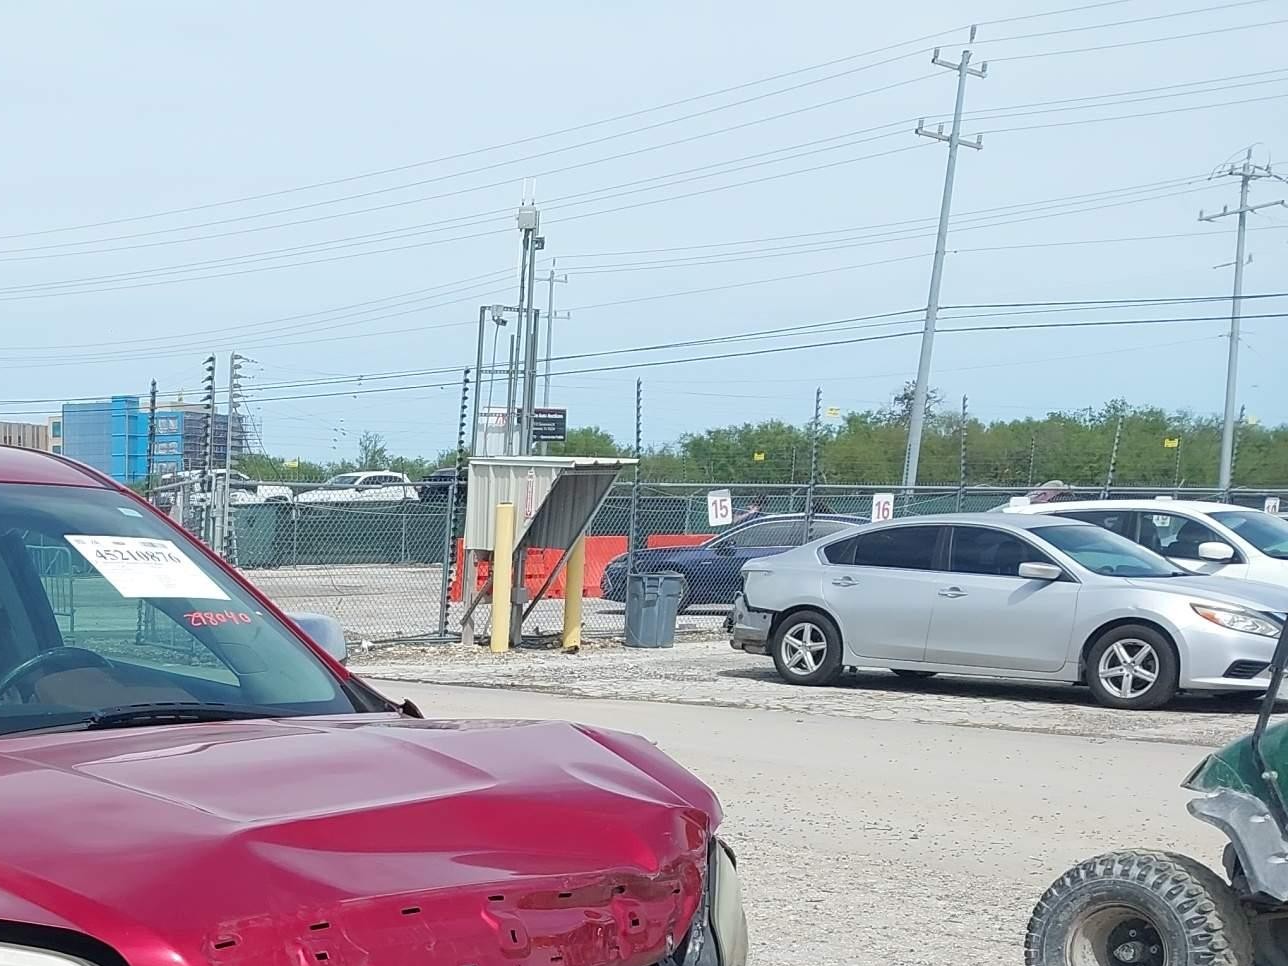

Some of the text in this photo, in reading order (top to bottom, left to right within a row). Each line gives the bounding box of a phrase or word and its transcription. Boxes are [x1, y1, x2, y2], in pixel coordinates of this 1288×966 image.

[712, 498, 729, 519] 15
[875, 501, 890, 520] 16
[95, 549, 182, 564] 45210876
